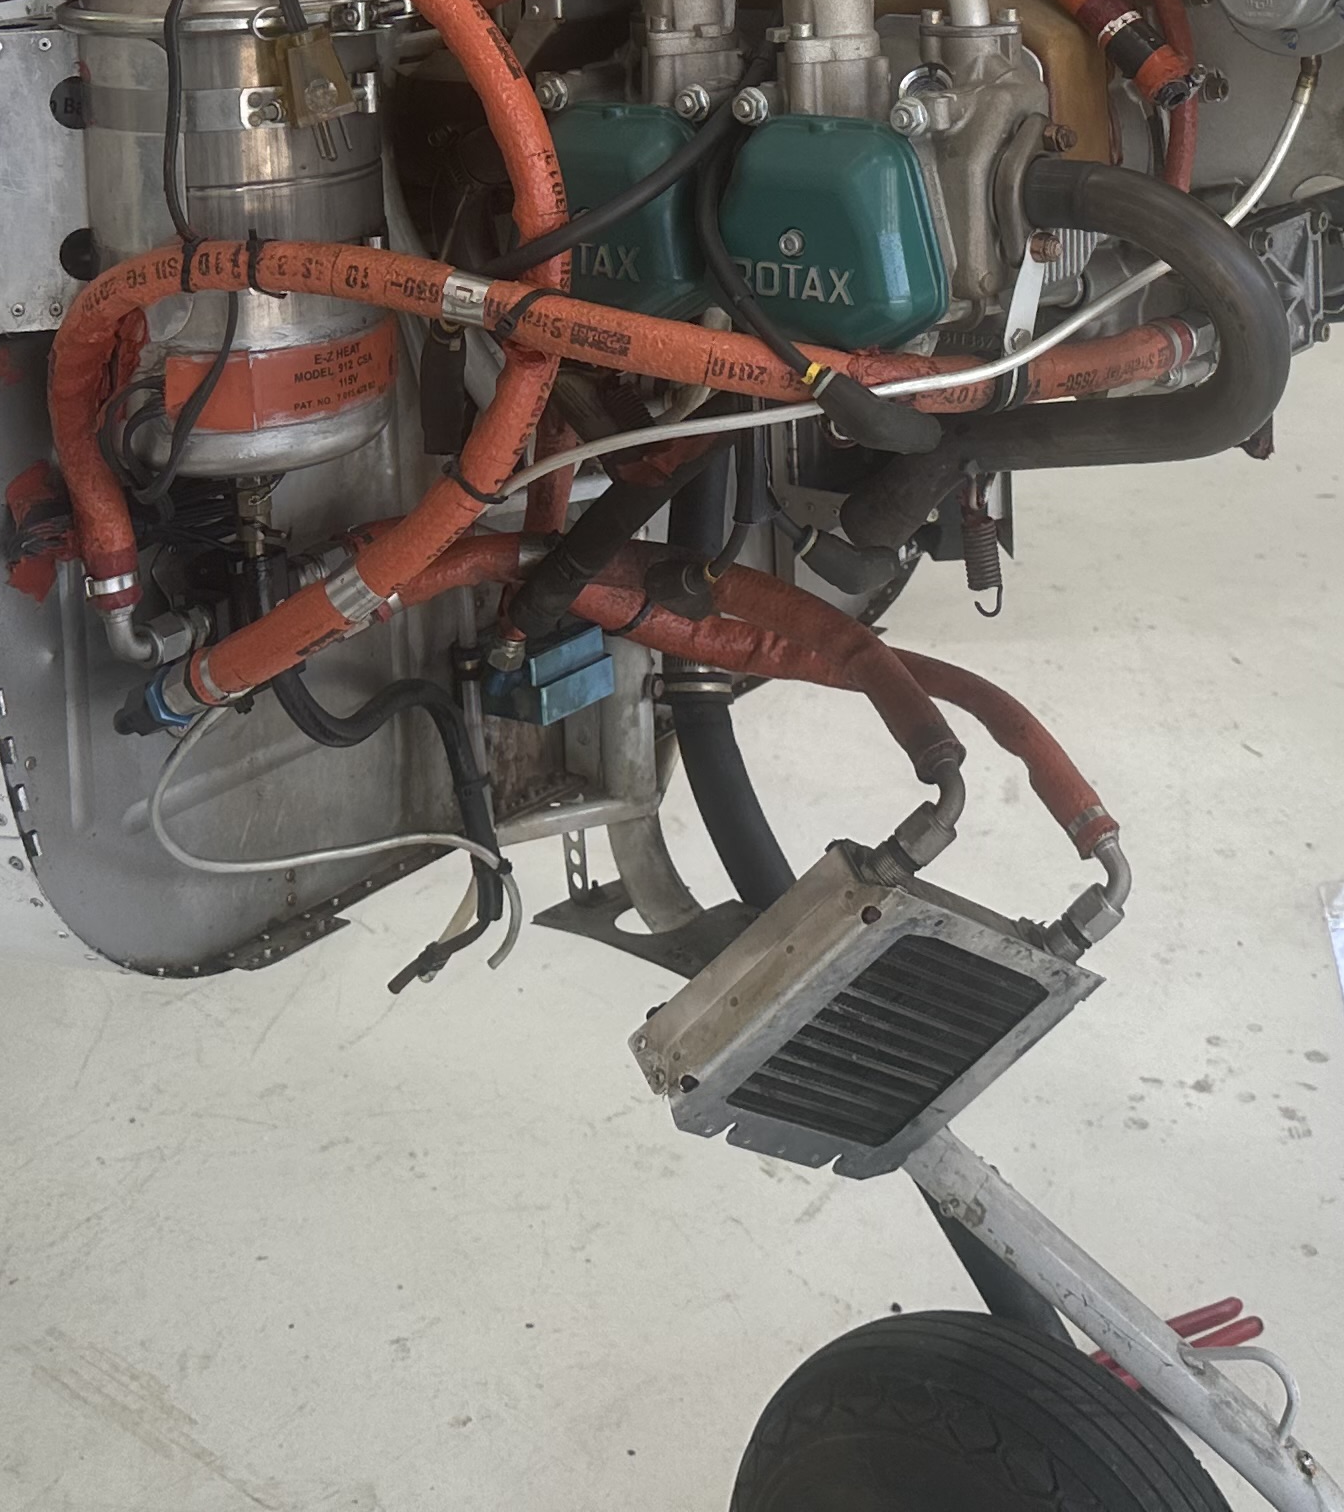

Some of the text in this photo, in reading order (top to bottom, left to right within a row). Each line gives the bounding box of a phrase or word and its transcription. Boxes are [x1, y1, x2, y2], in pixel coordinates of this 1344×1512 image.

[578, 242, 641, 284] TAX
[730, 257, 855, 305] ROTAX
[314, 341, 362, 365] E-Z HEAT
[294, 366, 335, 384] MODEL
[338, 360, 355, 373] 912
